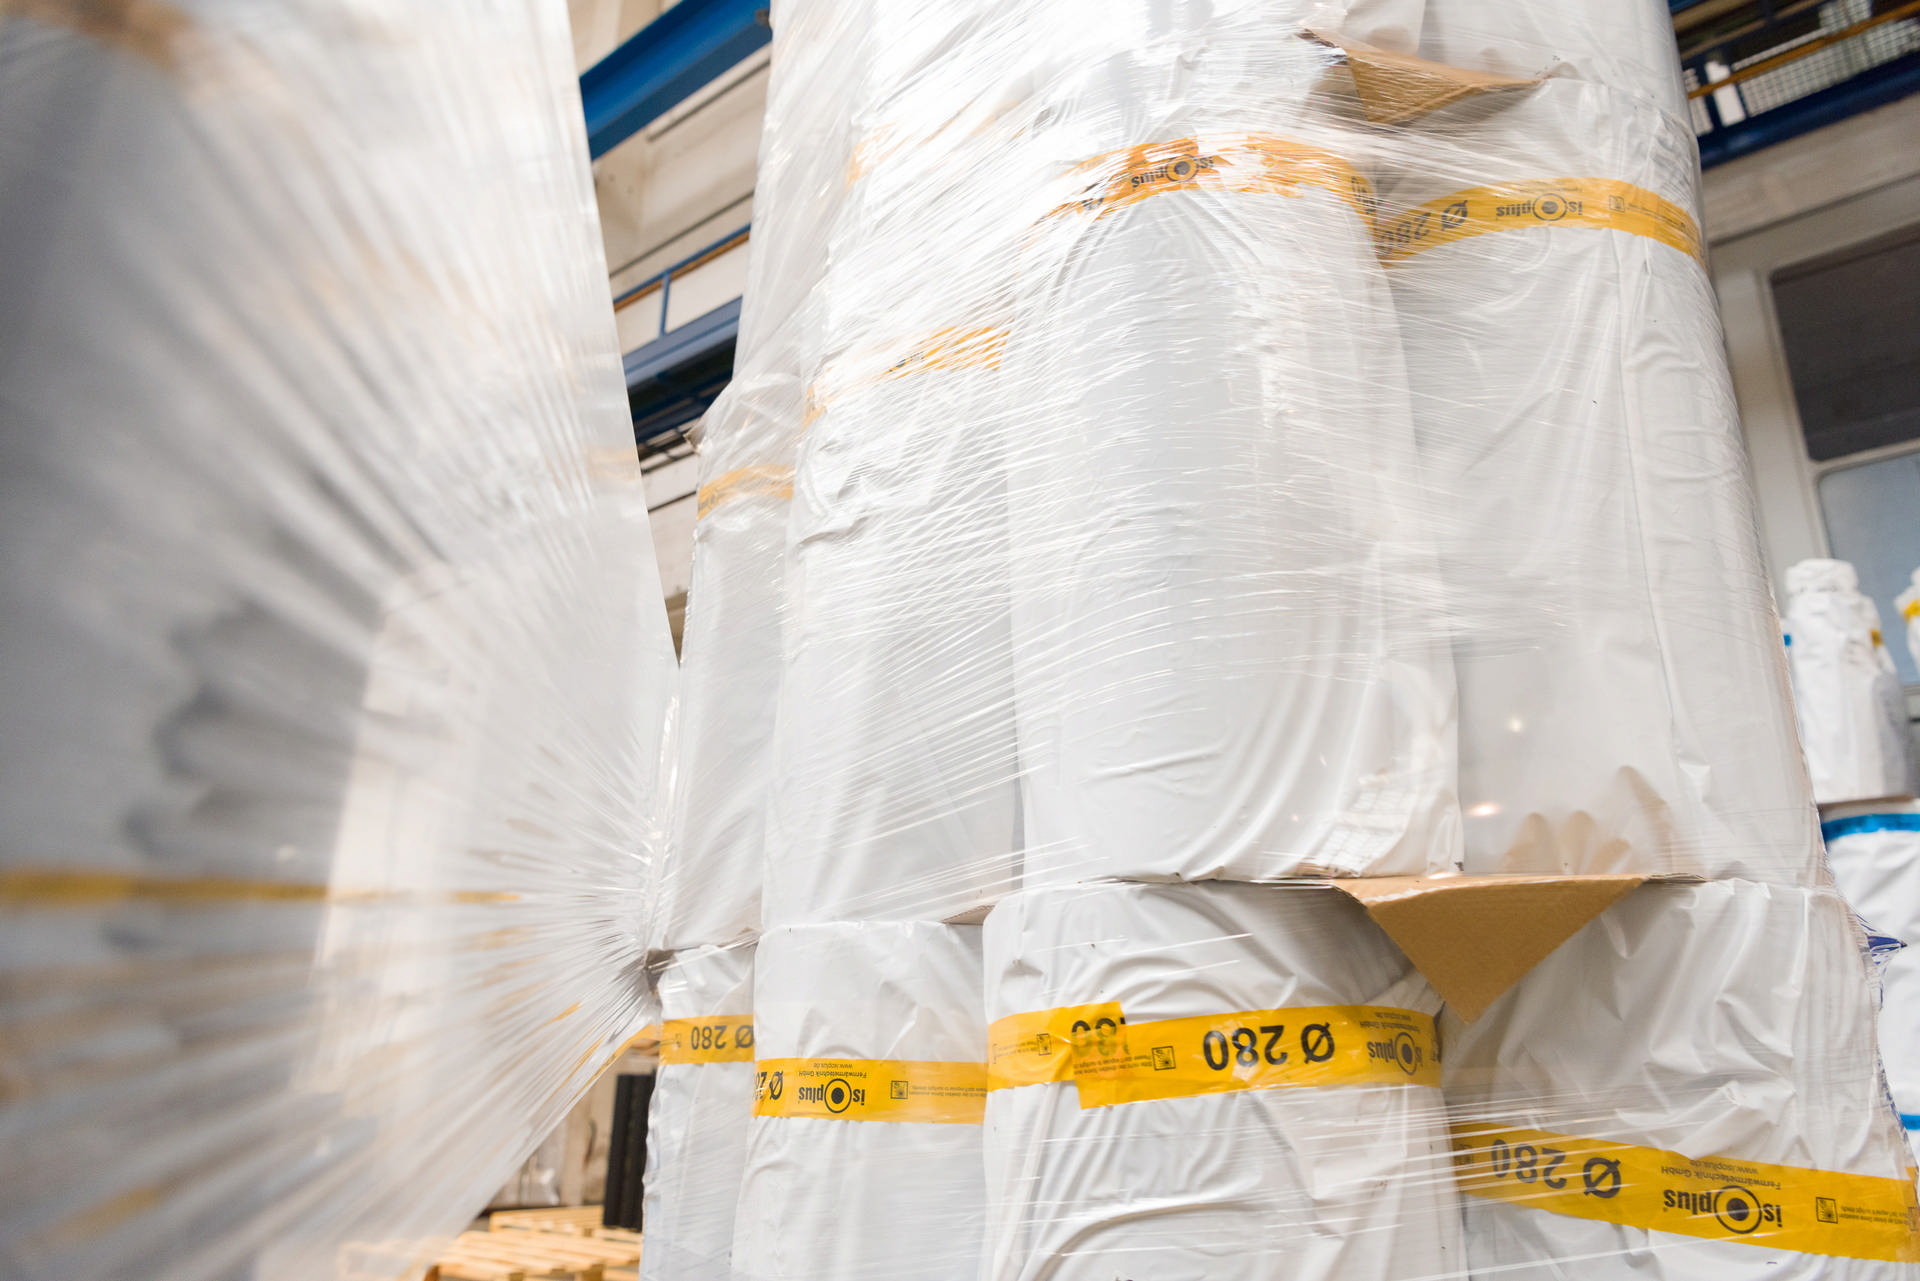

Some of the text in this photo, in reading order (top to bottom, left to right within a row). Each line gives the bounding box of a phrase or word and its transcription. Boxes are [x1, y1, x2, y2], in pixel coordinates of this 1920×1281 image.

[1496, 193, 1583, 222] isoplus
[691, 1024, 754, 1050] Ø 280
[1203, 1025, 1288, 1071] 280
[1301, 1021, 1336, 1064] Ø
[799, 1078, 866, 1114] isoplus
[1491, 1139, 1621, 1198] Ø 280
[1661, 1166, 1781, 1190] Fernwärmetechnik GmbH
[1688, 1159, 1759, 1175] www.isoplus.de
[1662, 1185, 1783, 1235] isoplus
